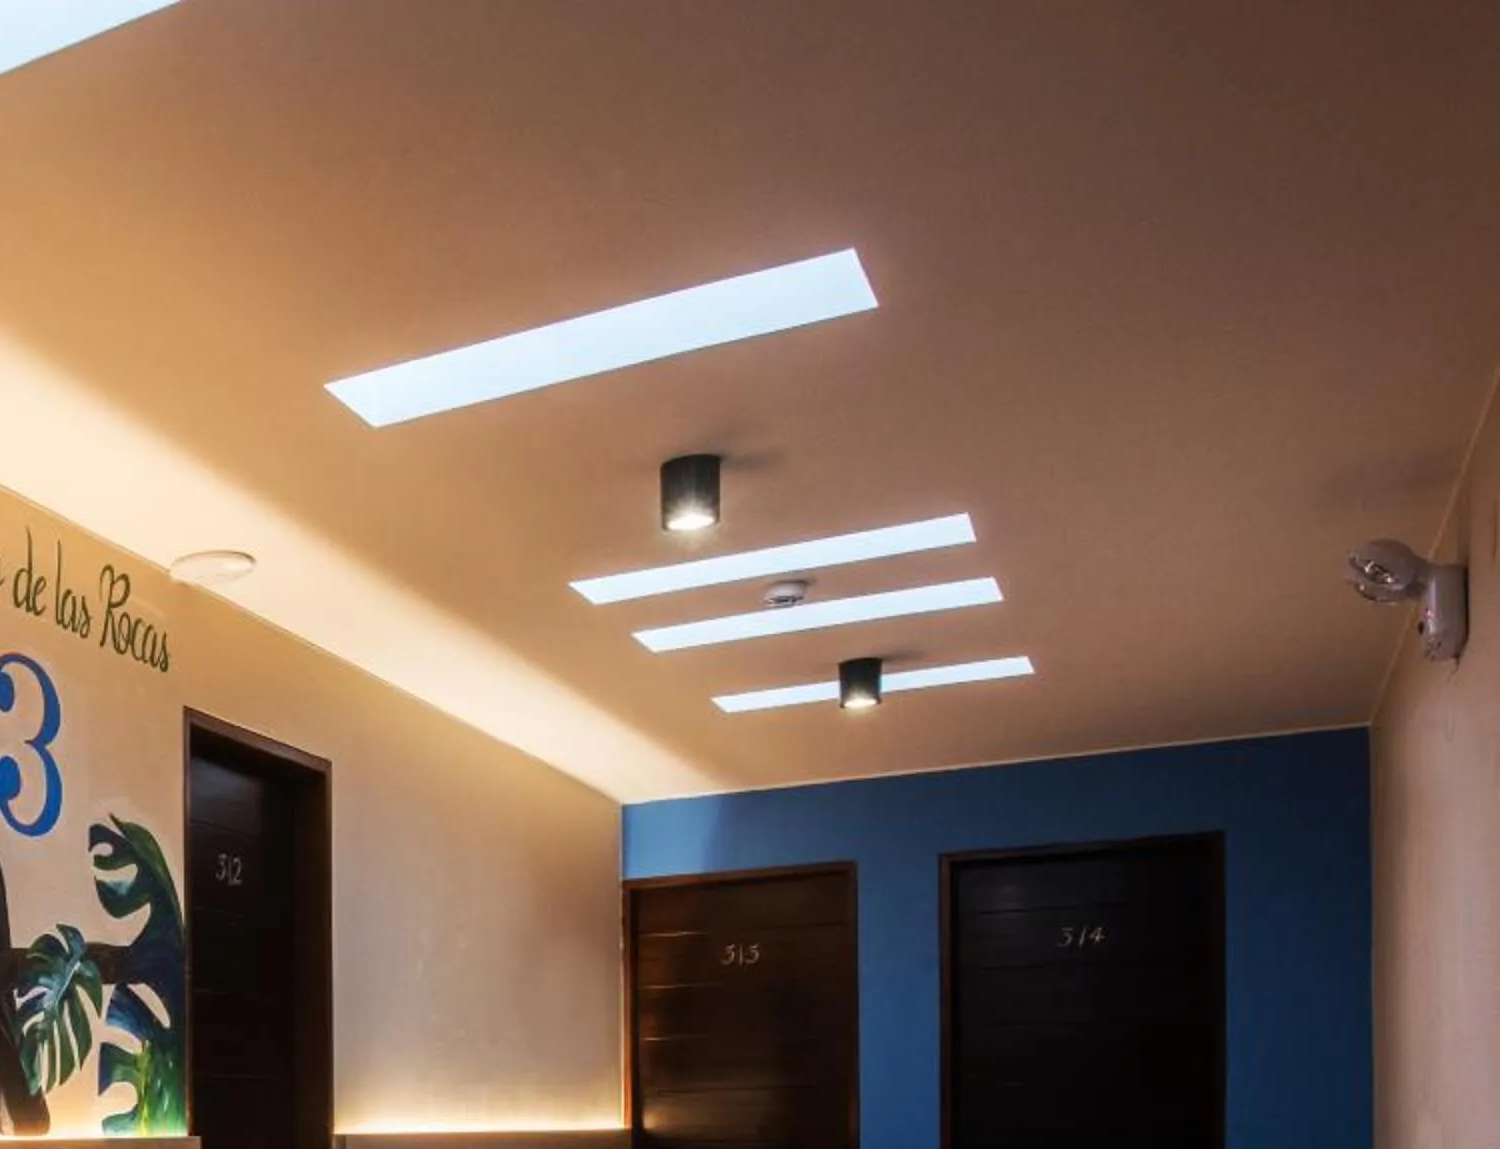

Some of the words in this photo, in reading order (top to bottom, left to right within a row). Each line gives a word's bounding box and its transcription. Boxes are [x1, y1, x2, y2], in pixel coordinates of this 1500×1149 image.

[12, 526, 47, 618] de
[54, 539, 91, 640] las
[100, 563, 172, 673] Rocas
[215, 853, 243, 886] 312
